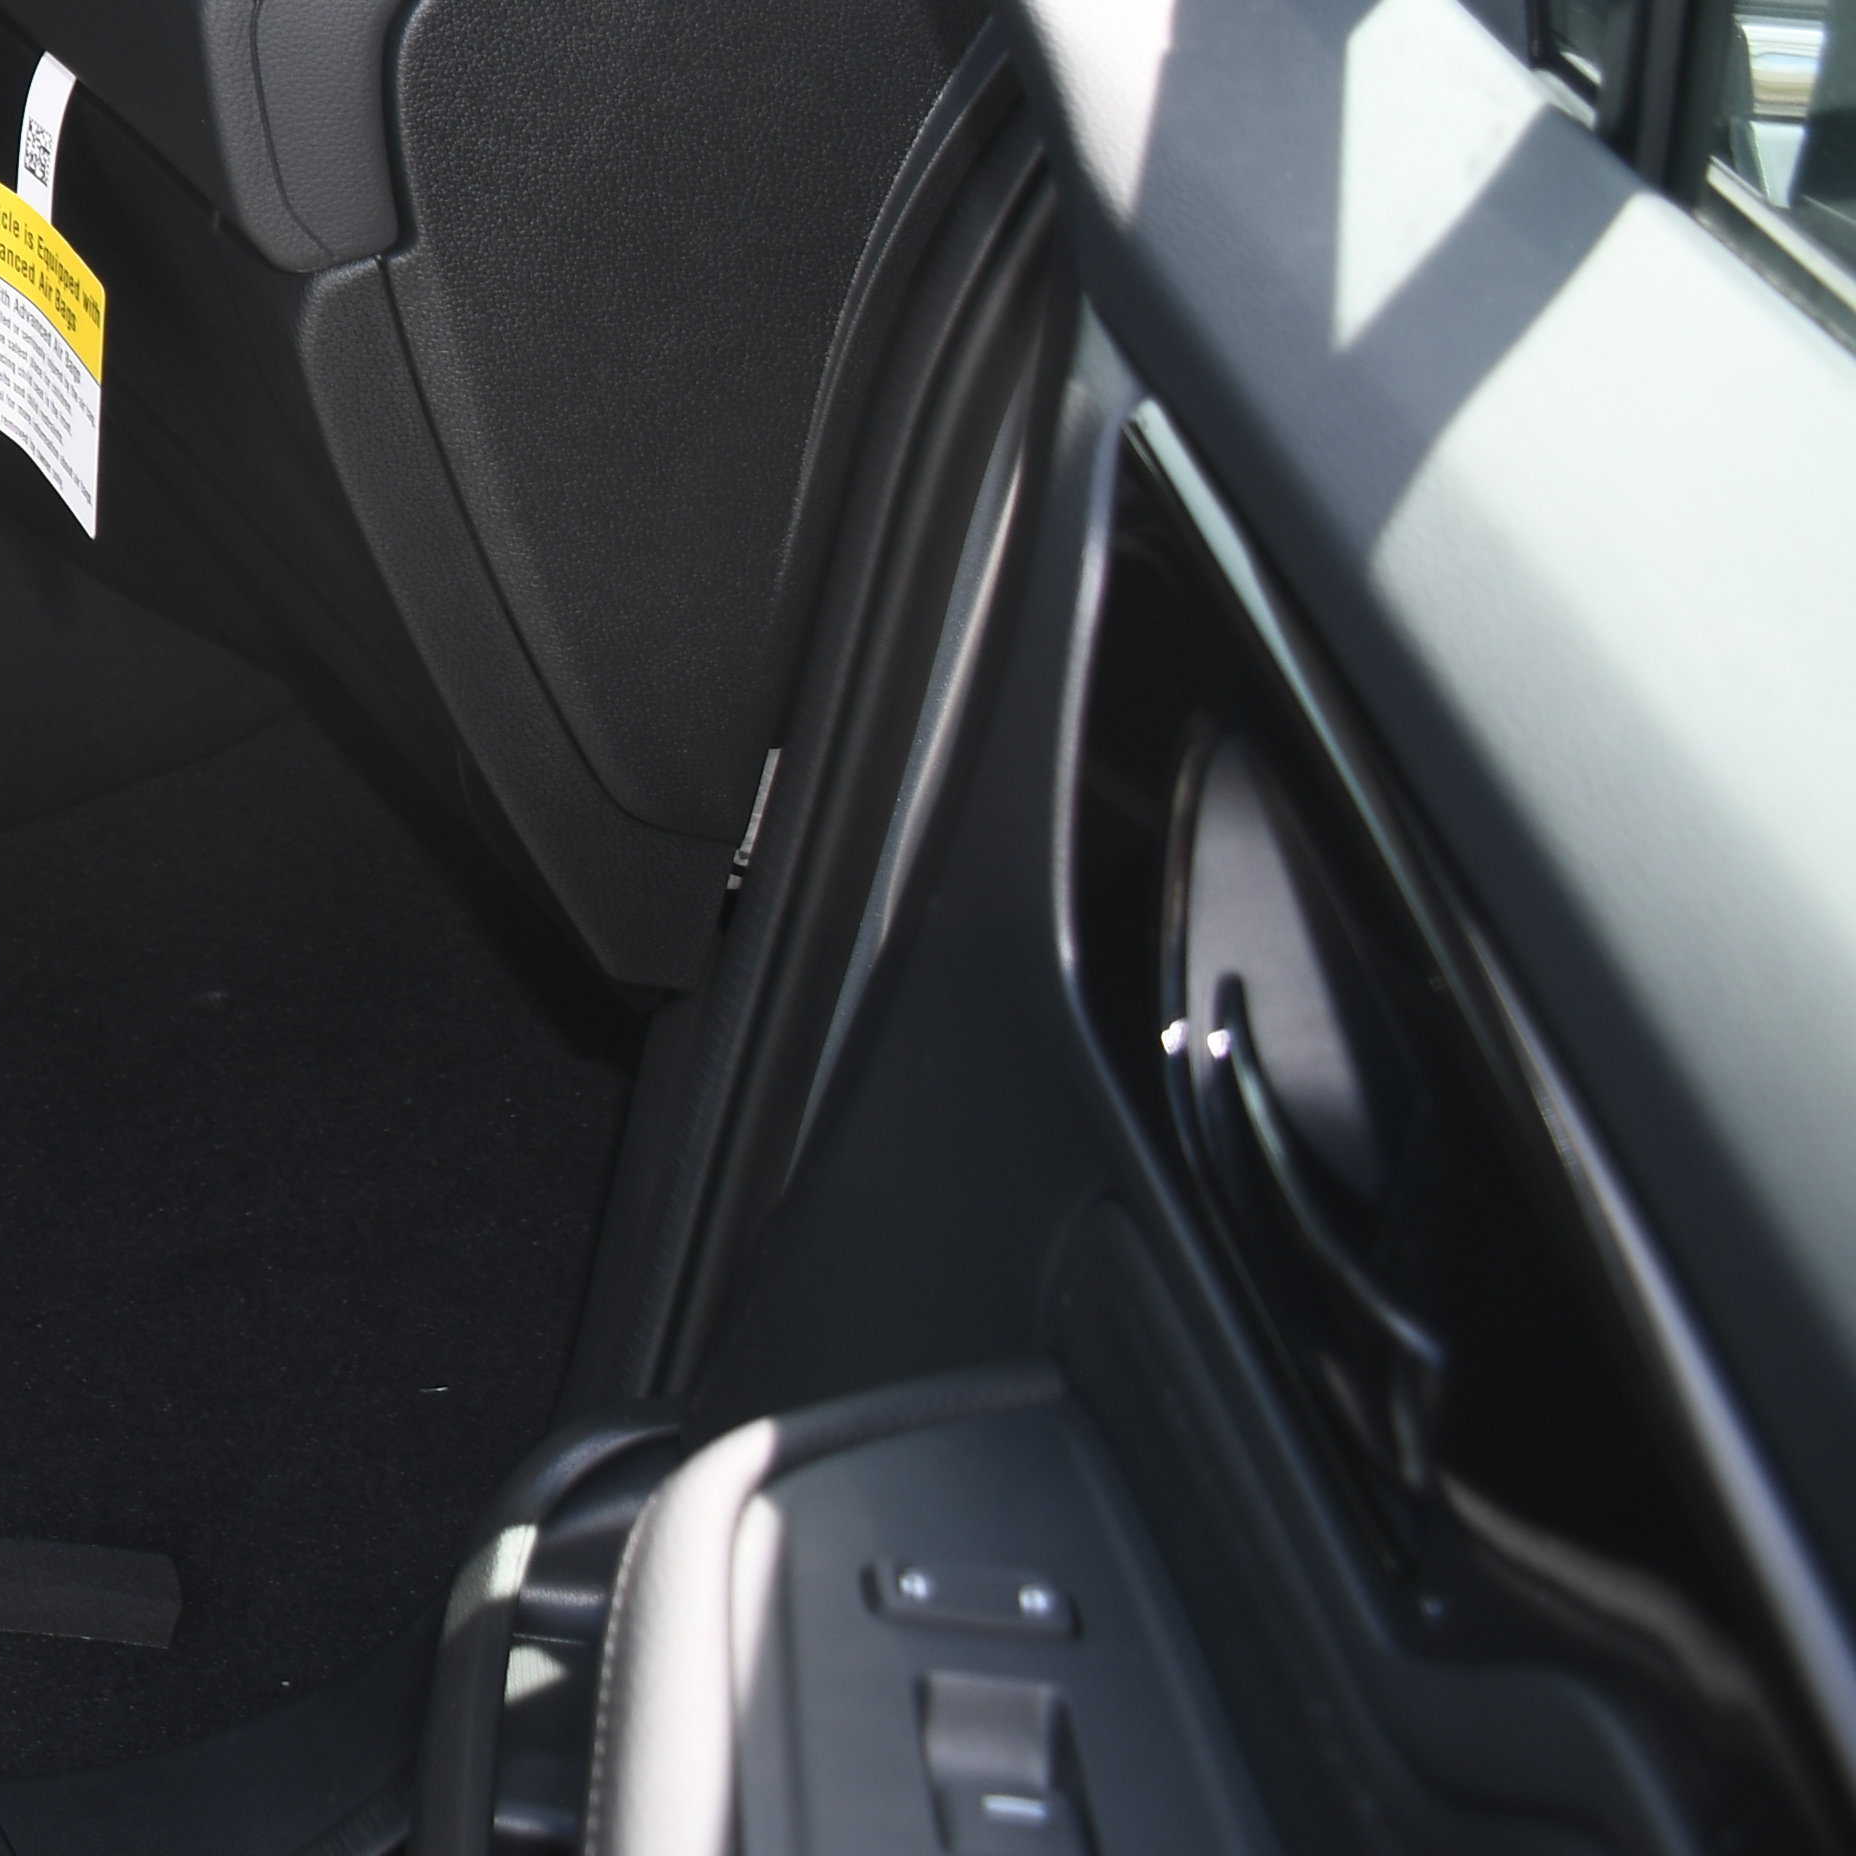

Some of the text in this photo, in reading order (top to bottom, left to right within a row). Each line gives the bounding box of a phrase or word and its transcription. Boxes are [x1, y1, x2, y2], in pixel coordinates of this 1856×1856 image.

[24, 222, 34, 251] is
[38, 235, 80, 302] Equipped
[82, 290, 101, 329] with
[38, 271, 53, 301] Air
[55, 287, 77, 332] Bags
[13, 298, 52, 347] Advanced
[53, 337, 64, 361] Air
[65, 348, 81, 384] Bags
